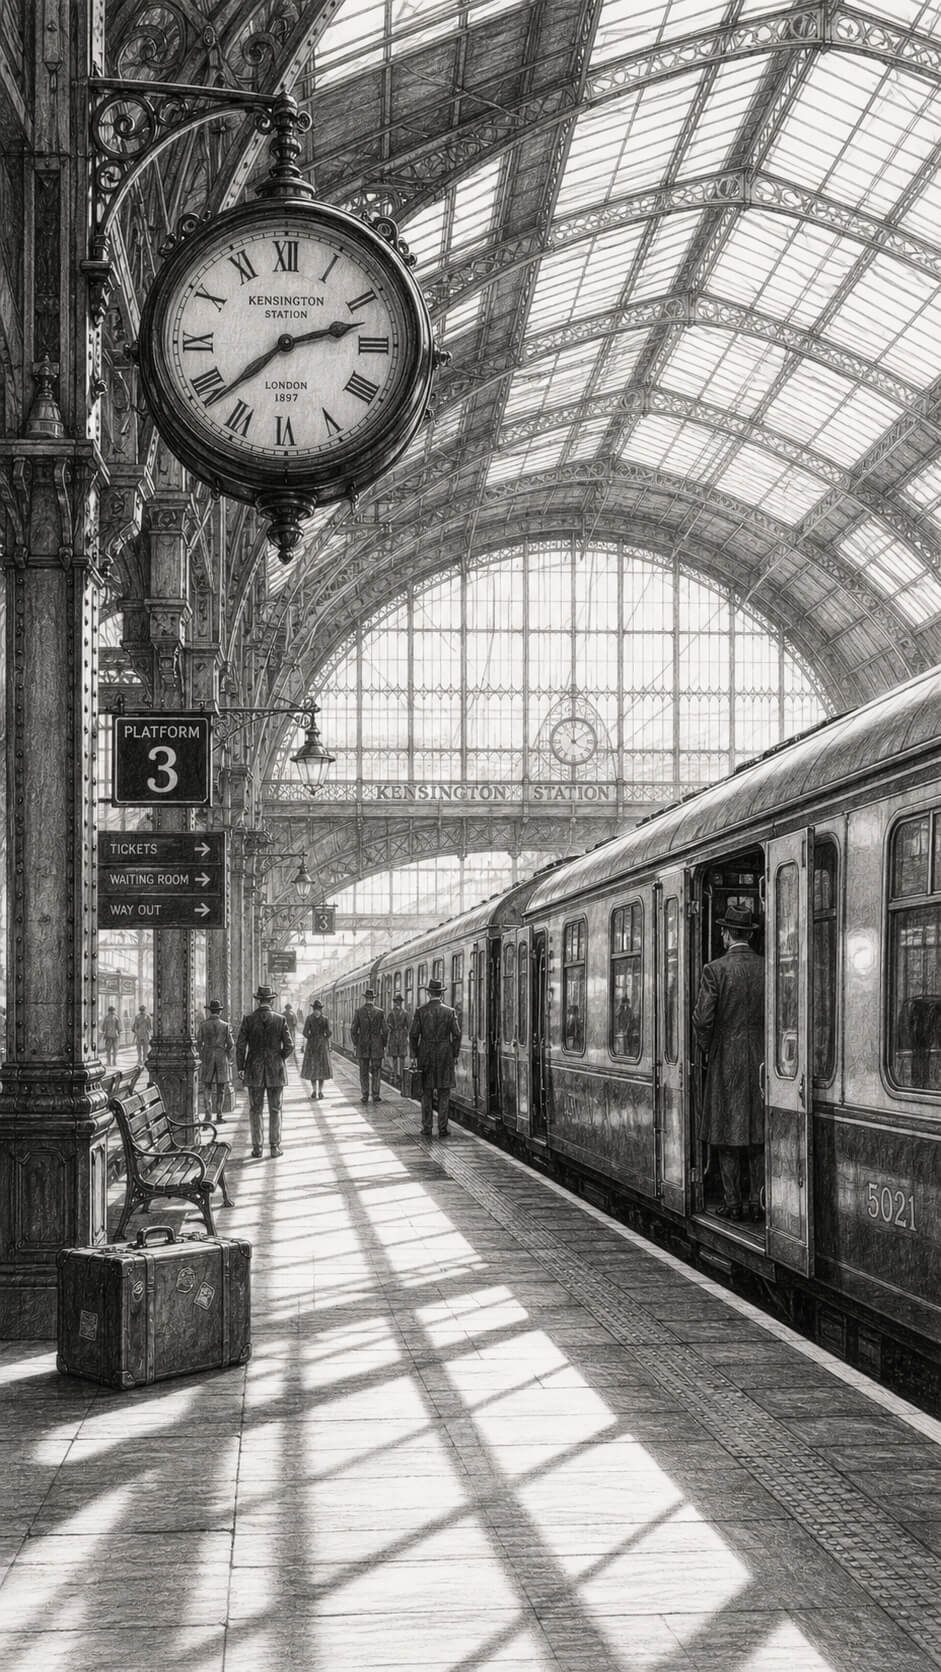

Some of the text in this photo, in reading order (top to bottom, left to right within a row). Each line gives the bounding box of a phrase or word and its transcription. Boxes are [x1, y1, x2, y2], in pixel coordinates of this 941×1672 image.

[227, 249, 259, 286] XI
[272, 240, 299, 273] XII
[319, 253, 340, 284] I
[194, 283, 228, 312] X
[248, 295, 325, 307] KENSINGTON
[345, 287, 378, 314] II
[264, 310, 308, 319] STATION
[182, 331, 214, 354] IX
[358, 335, 389, 355] III
[264, 381, 308, 390] LONDON
[342, 370, 380, 405] IIII
[274, 393, 299, 402] 1897
[223, 398, 255, 438] VII
[321, 407, 344, 438] V
[273, 415, 297, 446] VI
[123, 725, 201, 739] PLATFORM
[146, 746, 179, 793] 3
[376, 785, 610, 801] KENSINGTON STATION
[110, 843, 159, 855] TICKETS
[110, 874, 190, 886] WAITING ROOM
[110, 904, 162, 916] WAY OUT
[319, 914, 329, 931] 3
[867, 1182, 918, 1232] 5021
